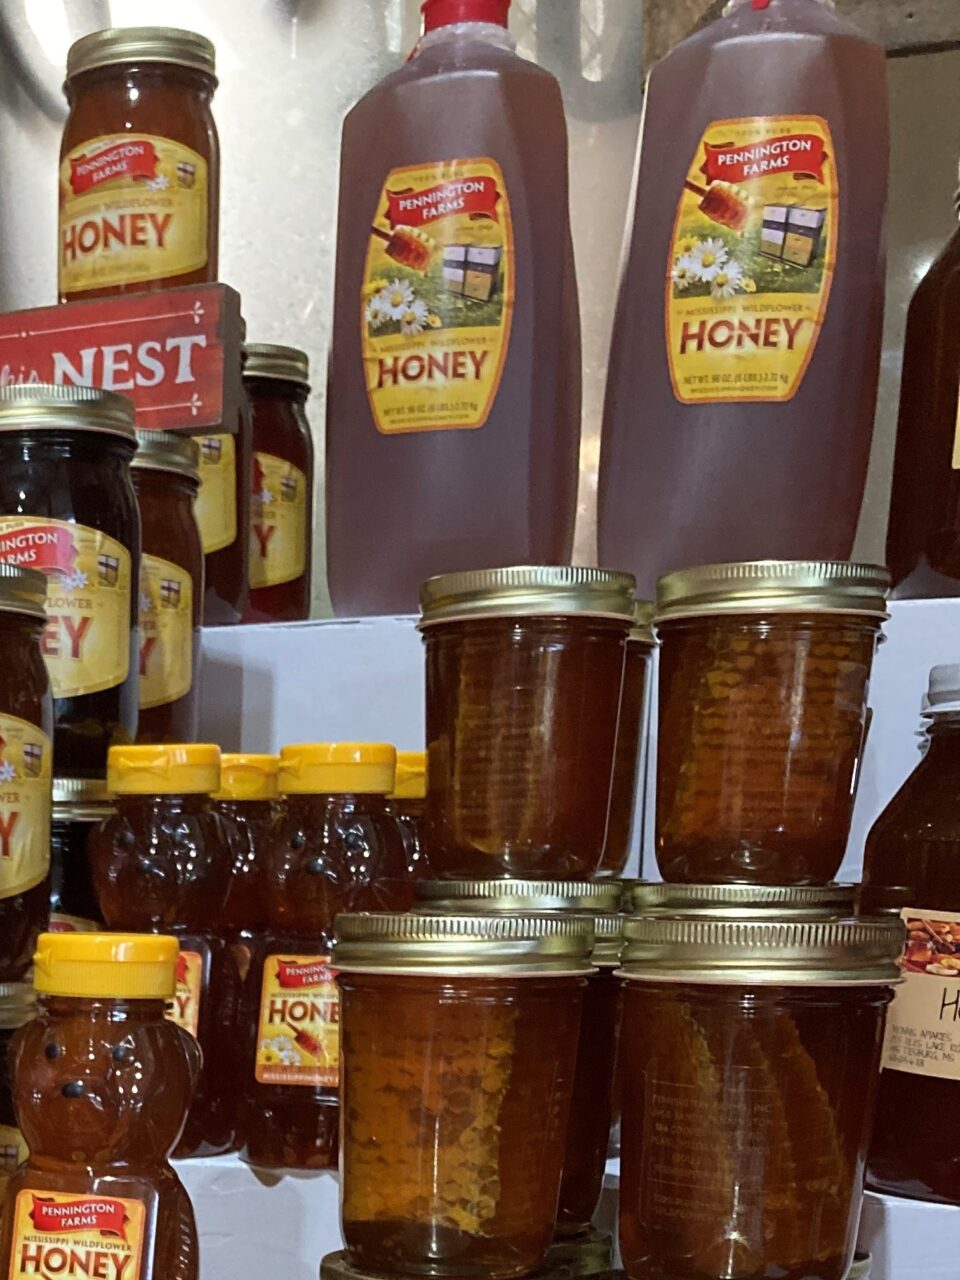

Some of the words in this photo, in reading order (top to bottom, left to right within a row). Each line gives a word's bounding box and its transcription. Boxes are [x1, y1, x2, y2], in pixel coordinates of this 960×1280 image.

[718, 140, 811, 165] PENNINGTON
[743, 156, 789, 176] FARMS
[399, 181, 485, 211] PENNINGTON
[422, 198, 465, 219] FARMS
[63, 213, 173, 267] HONEY
[680, 318, 804, 354] HONEY
[53, 335, 207, 391] NEST
[378, 351, 489, 388] HONEY
[47, 598, 93, 610] LOWER
[268, 1000, 339, 1023] HONE
[42, 1203, 115, 1216] PENNINGTON
[61, 1216, 97, 1227] FARMS
[23, 1235, 69, 1245] MISSISSIPPI
[73, 1240, 132, 1251] WILDFLOWER
